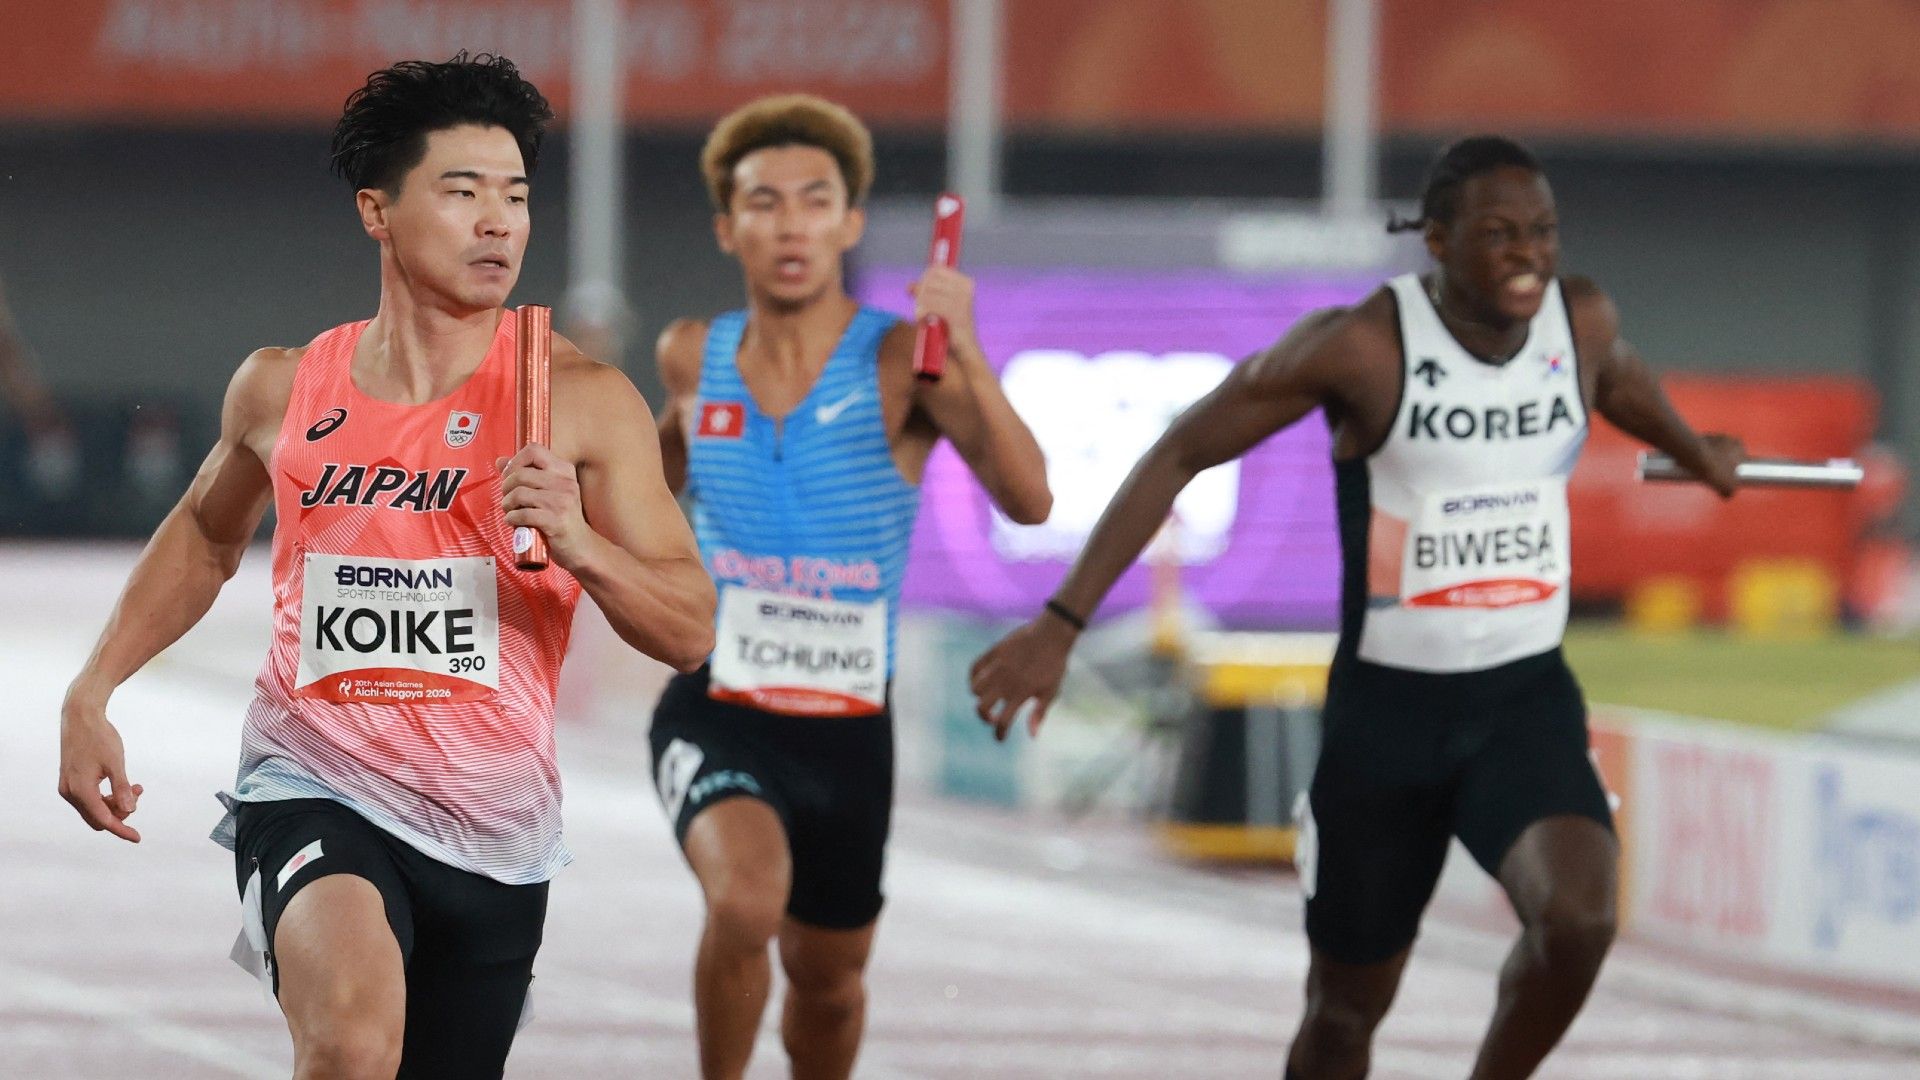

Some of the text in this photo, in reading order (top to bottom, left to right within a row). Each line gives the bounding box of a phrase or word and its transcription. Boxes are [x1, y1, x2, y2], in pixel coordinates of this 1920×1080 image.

[1408, 397, 1575, 440] KOREA
[300, 463, 469, 513] JAPAN
[1416, 521, 1552, 569] BIWESA
[335, 565, 453, 589] BORNAN
[337, 588, 452, 602] SPORTS TECHNOLOGY
[316, 605, 475, 655] KOIKE
[449, 656, 486, 673] 390
[738, 633, 875, 675] T.CHUNG
[354, 688, 452, 700] Aichi-Nagoya 2026
[373, 680, 395, 688] Asian
[396, 681, 424, 689] Games
